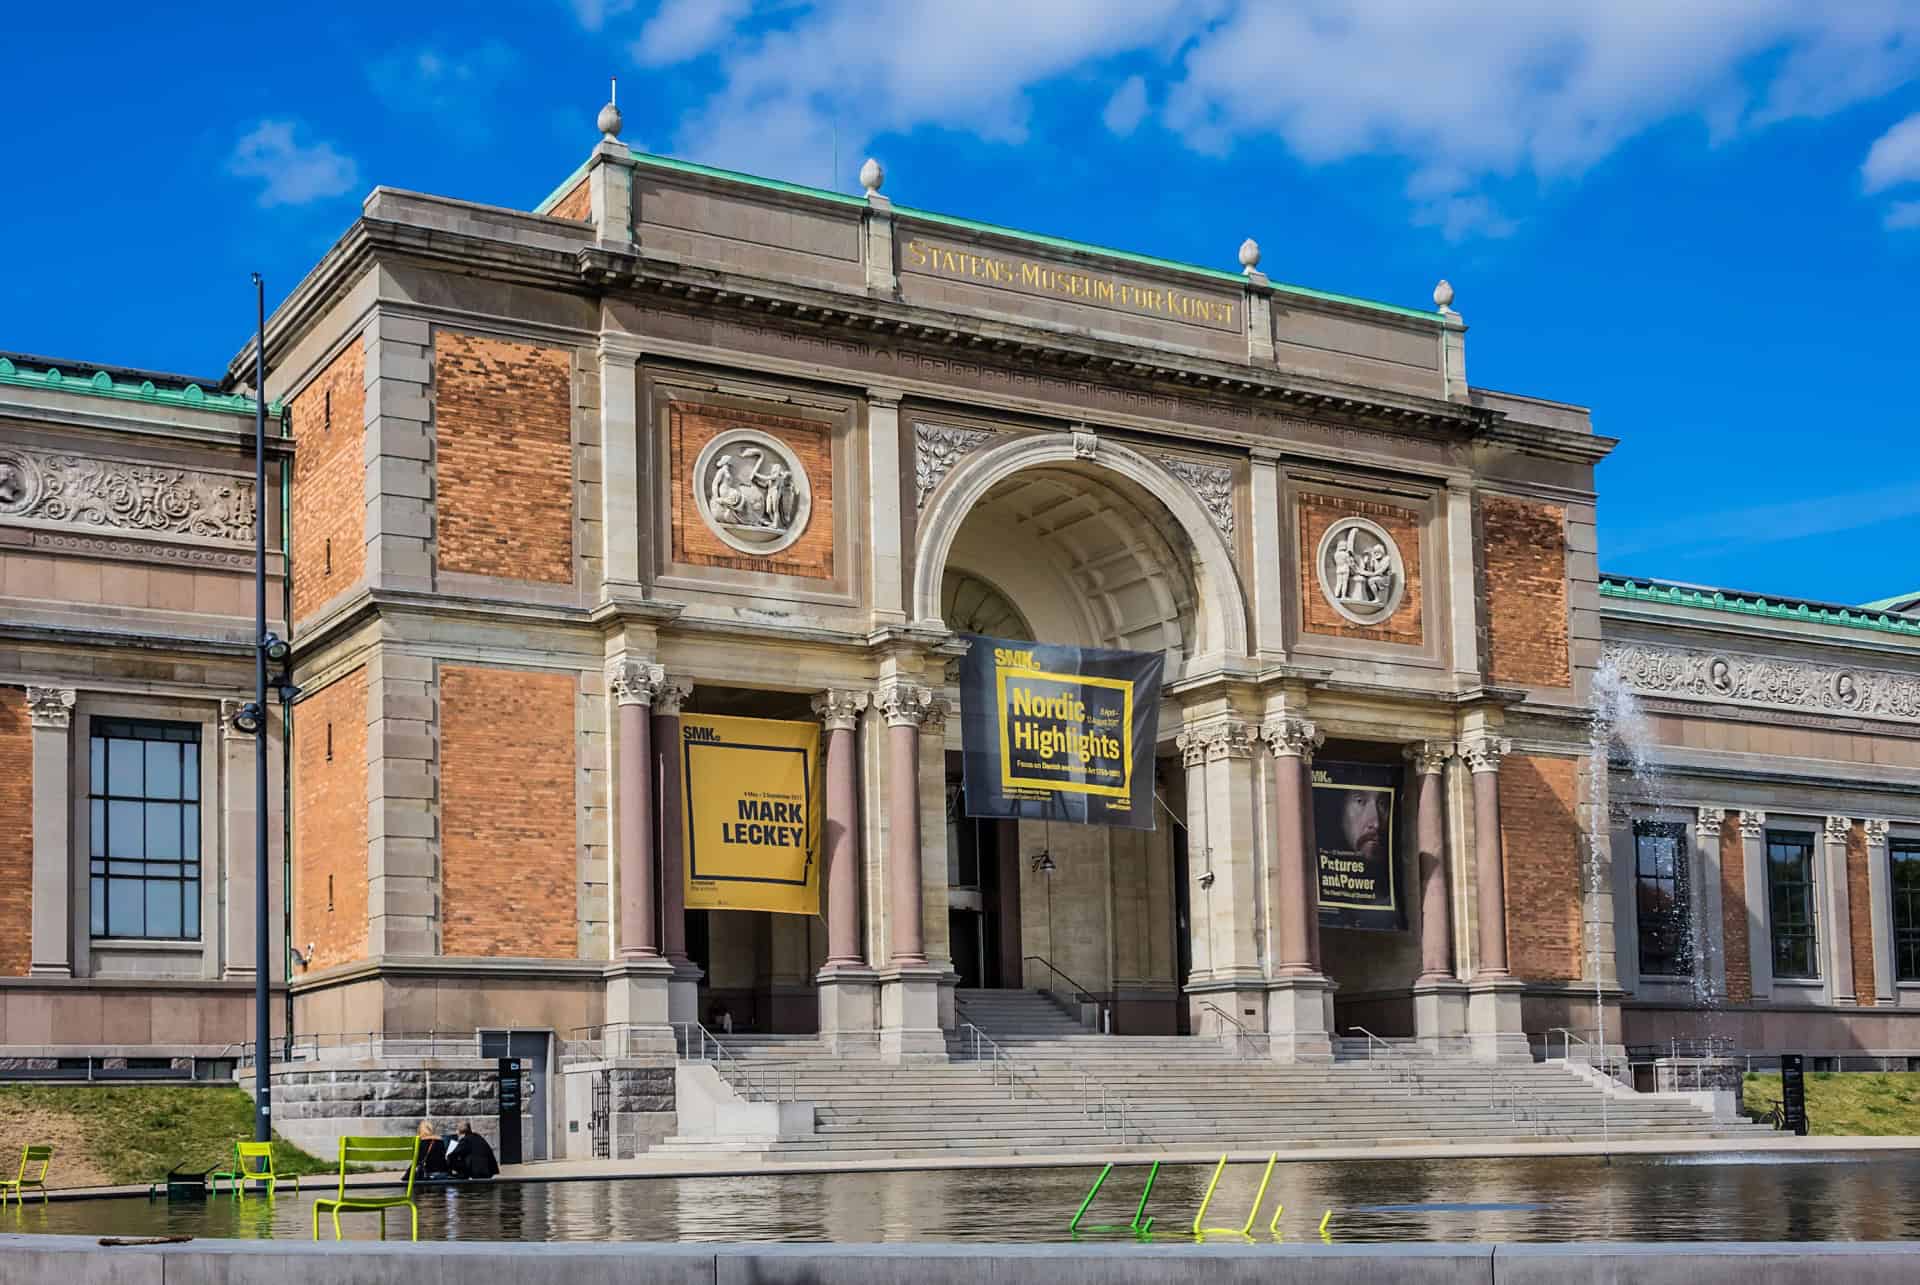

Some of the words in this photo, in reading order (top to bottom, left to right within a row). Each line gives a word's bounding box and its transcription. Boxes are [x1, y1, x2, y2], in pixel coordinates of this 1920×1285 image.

[908, 239, 1013, 284] STATENS
[1021, 261, 1115, 304] MUSEUM
[1167, 289, 1233, 324] KUNST
[1013, 687, 1086, 723] Nordic
[1014, 721, 1120, 763] Highlights
[738, 799, 803, 825] MARK
[722, 822, 803, 848] LECKEY
[1340, 874, 1376, 891] Power
